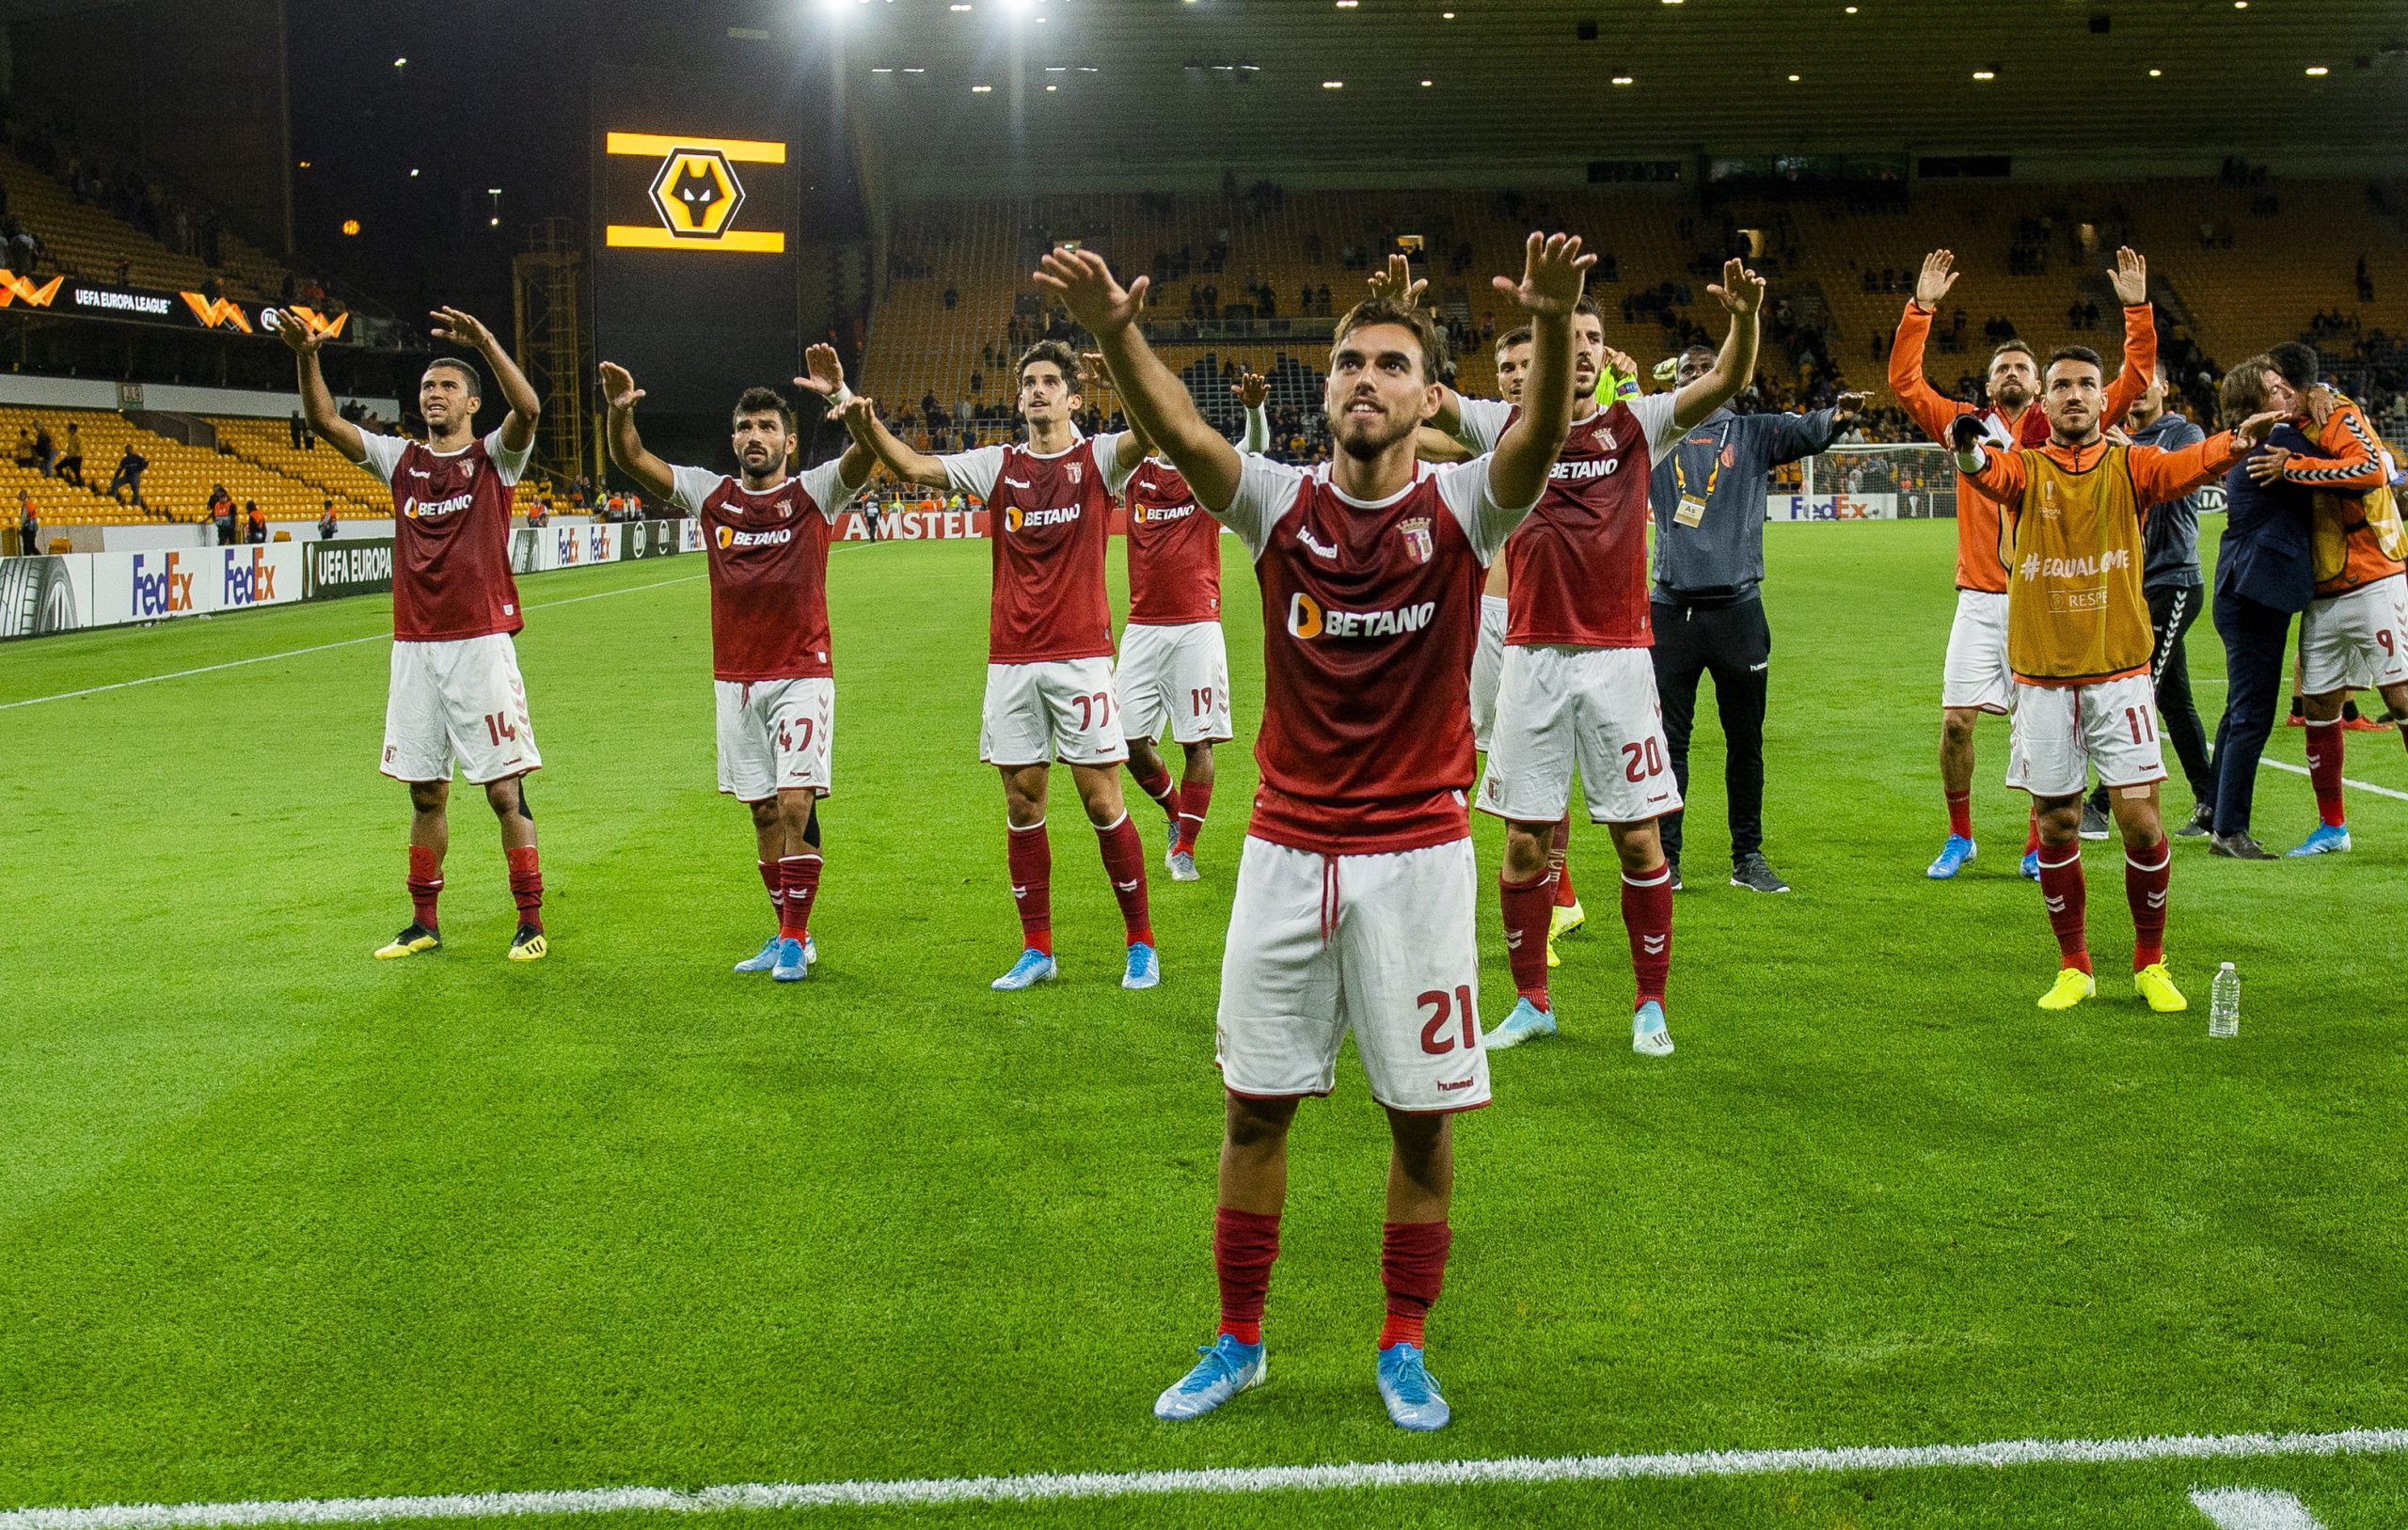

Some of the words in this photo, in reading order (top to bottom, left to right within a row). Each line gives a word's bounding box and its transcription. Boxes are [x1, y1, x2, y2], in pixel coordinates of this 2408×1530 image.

[75, 289, 100, 306] UEFA
[101, 292, 134, 310] EUROPA
[135, 296, 169, 314] LEAGUE
[1548, 459, 1618, 479] BETANO
[418, 494, 472, 515] BETANO
[1024, 503, 1080, 527] BETANO
[1147, 505, 1196, 520] BETANO
[1791, 496, 1868, 519] FedEx
[733, 528, 791, 545] BETANO
[843, 512, 983, 540] AMSTEL
[1295, 525, 1338, 560] hummel
[558, 528, 579, 565] FedEx
[590, 526, 611, 561] FedEx
[224, 546, 276, 606] FedEx
[318, 550, 349, 586] UEFA
[351, 546, 392, 583] EUROPA
[132, 551, 194, 616] FedEx
[2069, 591, 2108, 607] RESPE
[1324, 601, 1435, 637] BETANO
[2376, 629, 2394, 657] 9
[1072, 692, 1110, 732] 77
[1191, 686, 1212, 717] 19
[484, 711, 515, 747] 14
[779, 718, 813, 752] 47
[2126, 704, 2154, 745] 11
[1622, 735, 1663, 782] 20
[1417, 985, 1475, 1054] 21
[1437, 1076, 1474, 1091] hummel
